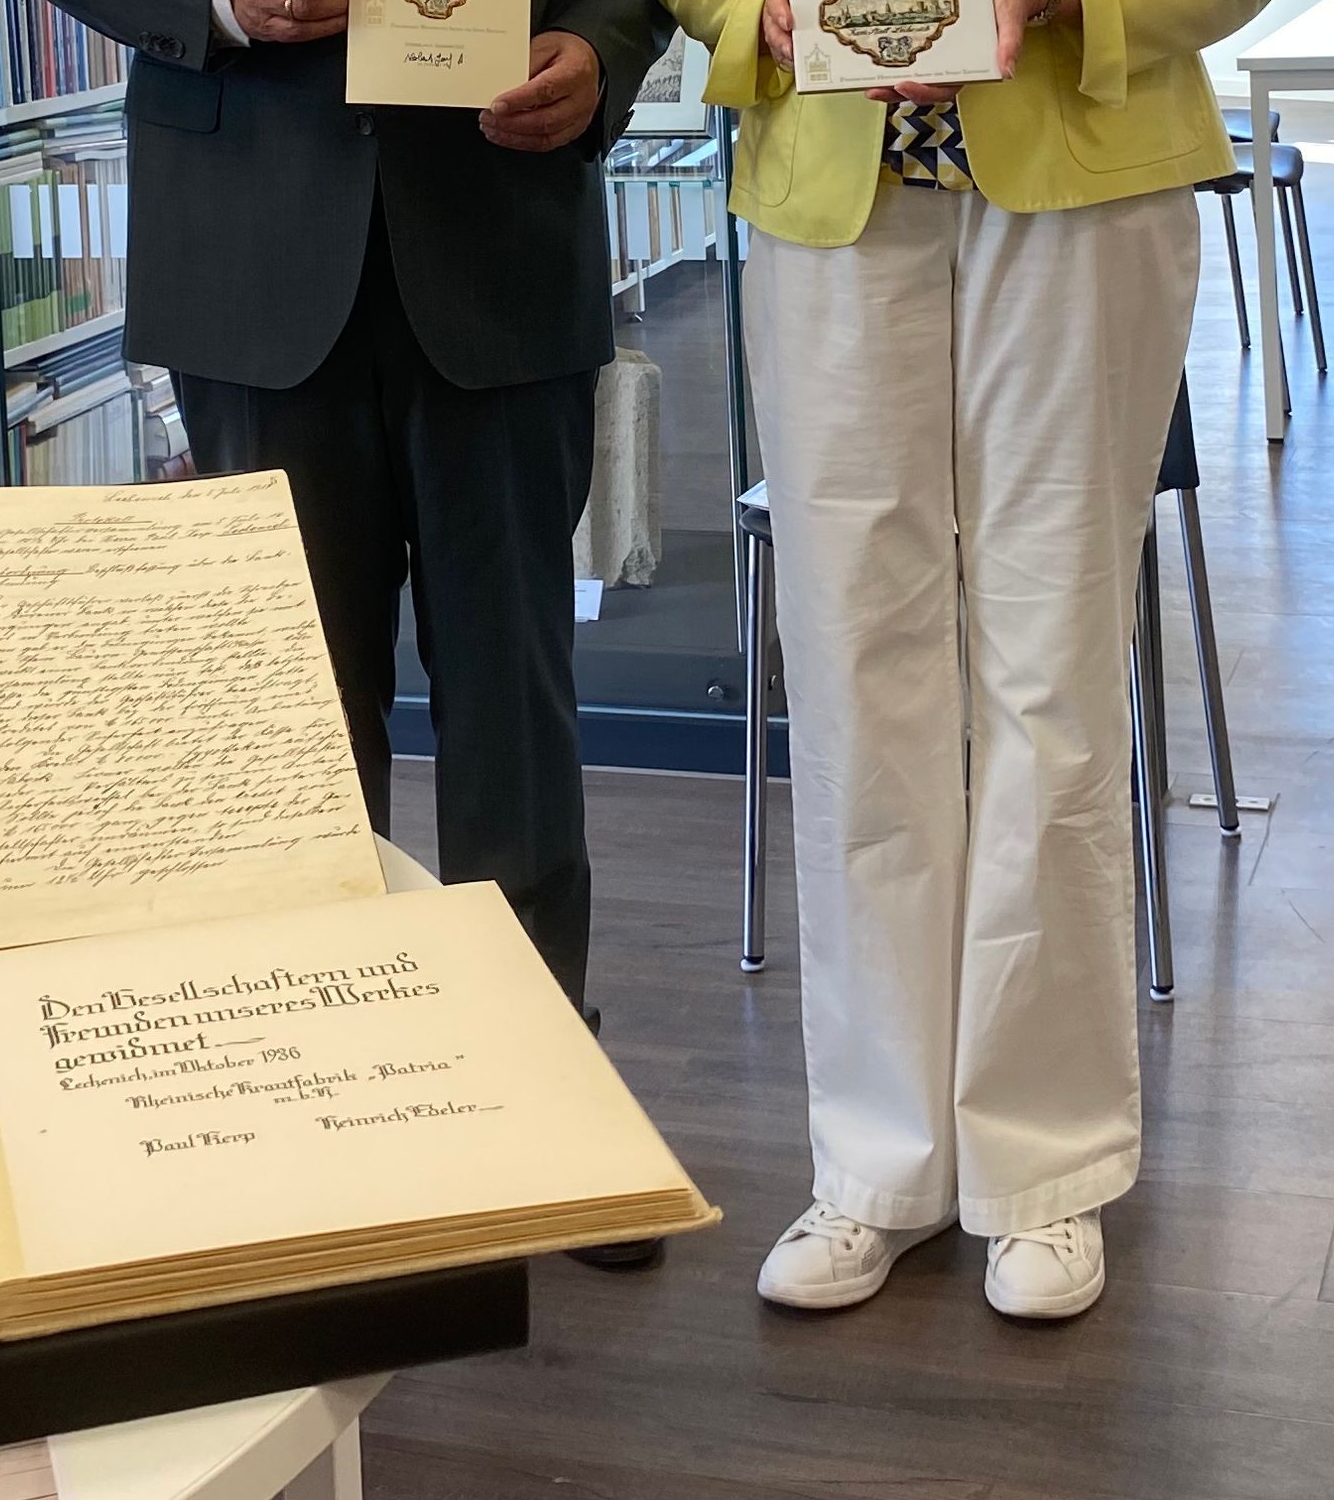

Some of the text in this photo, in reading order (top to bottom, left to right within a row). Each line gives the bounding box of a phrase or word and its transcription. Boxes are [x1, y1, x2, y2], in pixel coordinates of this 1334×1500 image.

[38, 951, 419, 1021] Den Gesellschaftern und
[39, 977, 441, 1049] Freunden unseres Werkes
[55, 1031, 212, 1074] gewidmet
[153, 1068, 177, 1079] im
[173, 1055, 255, 1075] Oktober
[125, 1084, 234, 1110] Rheinische
[314, 1106, 410, 1132] Heinrich
[138, 1131, 256, 1158] Paul Kerp
